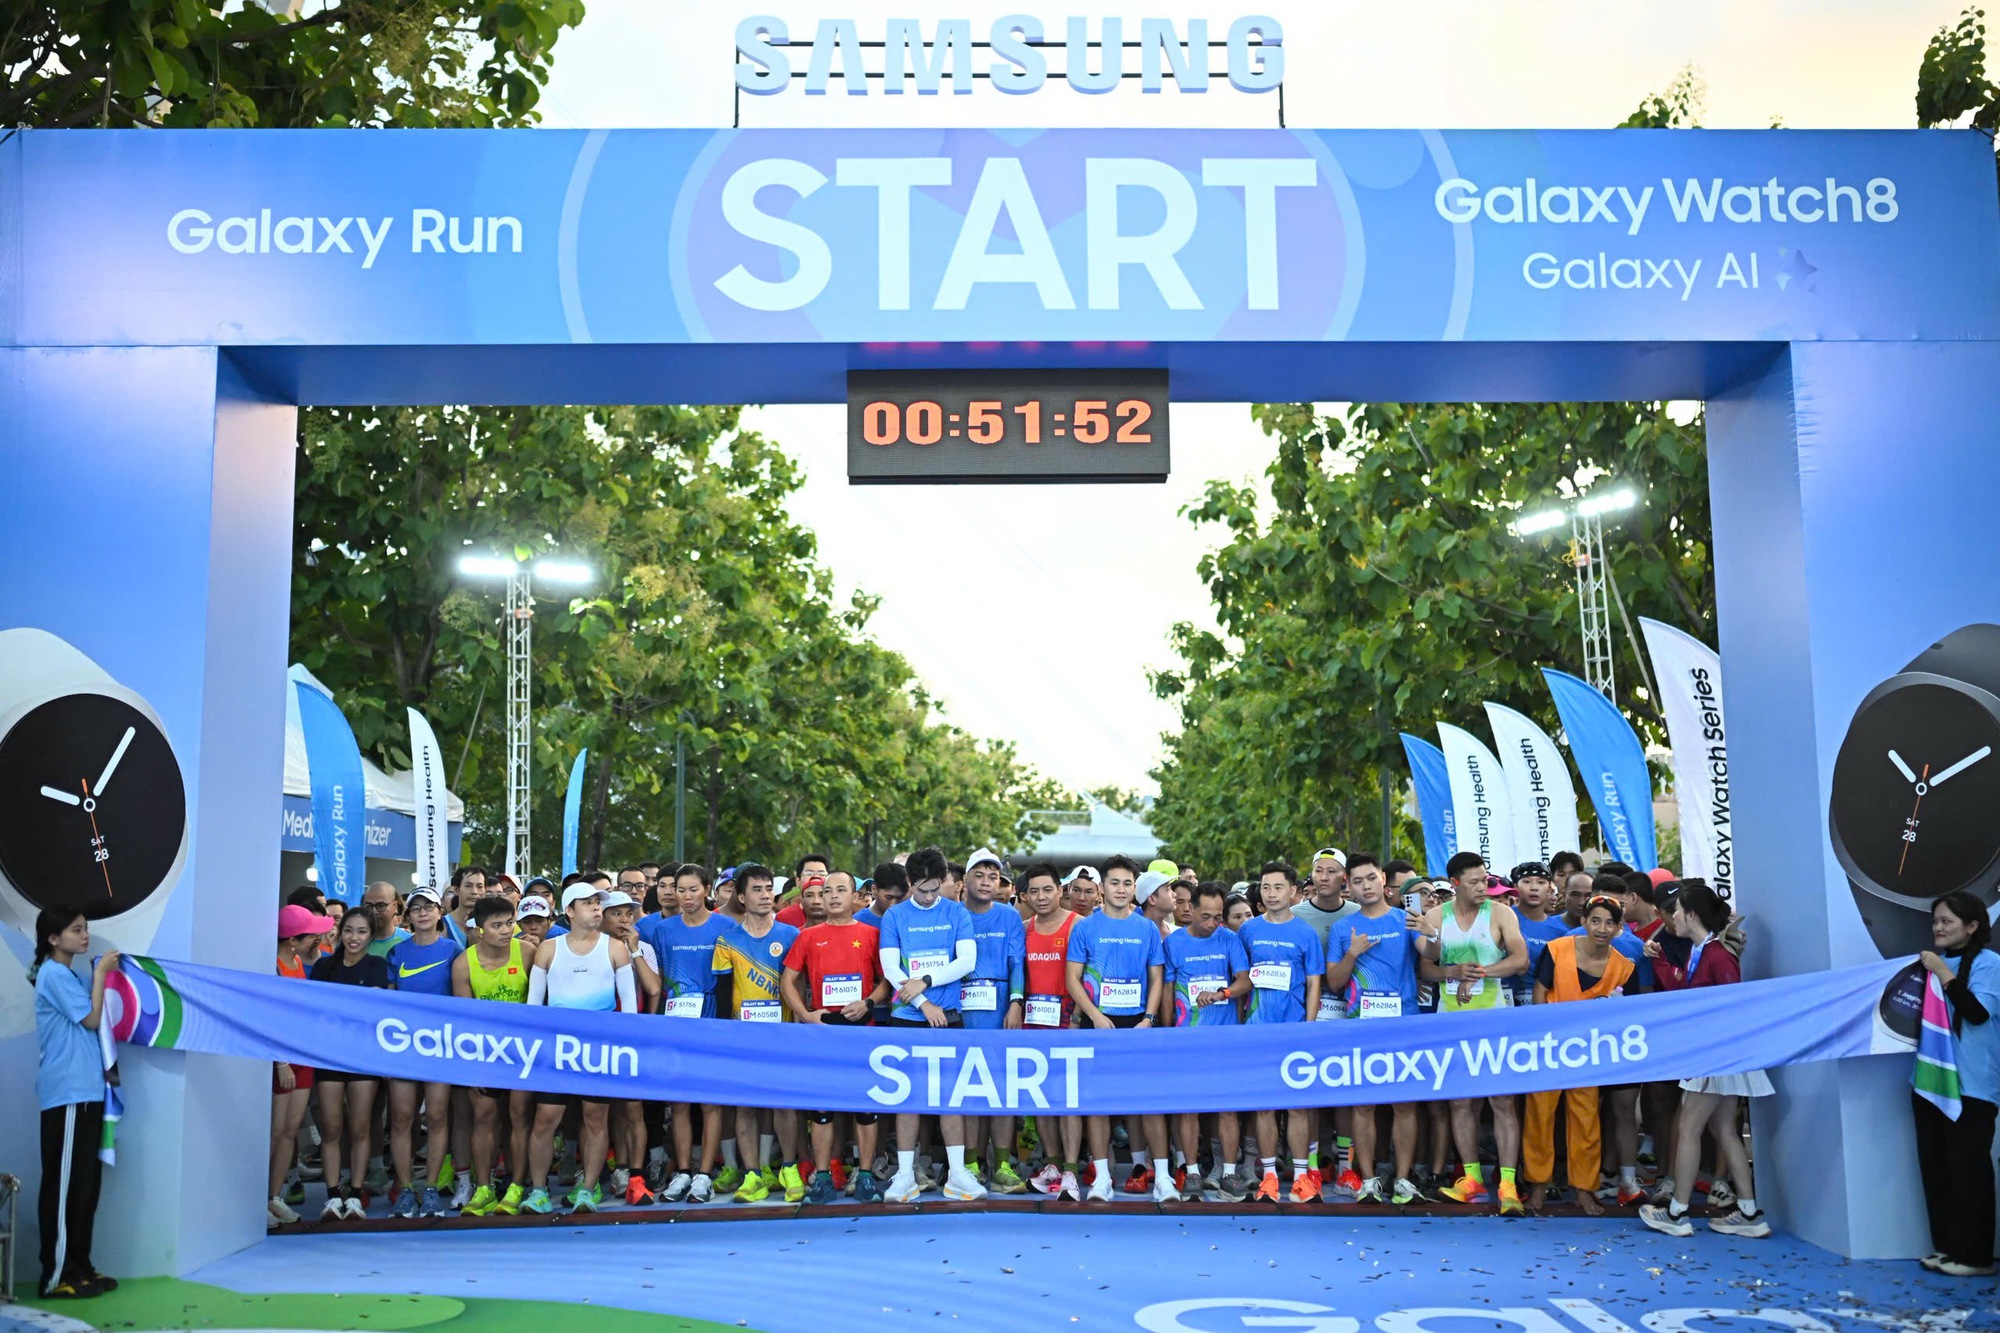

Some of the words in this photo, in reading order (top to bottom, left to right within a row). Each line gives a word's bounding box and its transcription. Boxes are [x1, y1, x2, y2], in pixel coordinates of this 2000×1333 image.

[734, 14, 1285, 96] SAMSUNG
[714, 156, 1317, 312] START
[1434, 178, 1653, 236] Galaxy
[1662, 177, 1900, 224] Watch8
[166, 208, 394, 269] Galaxy
[412, 208, 524, 254] Run
[1522, 252, 1703, 301] Galaxy
[1716, 252, 1759, 289] AI
[862, 399, 1152, 445] 00:51:52
[1691, 667, 1725, 742] Series
[423, 745, 433, 800] Health
[1467, 754, 1487, 803] Health
[1520, 737, 1545, 792] Health
[1602, 771, 1620, 807] Run
[1707, 745, 1731, 827] Watch
[332, 784, 344, 821] Run
[1905, 817, 1920, 828] SAT
[90, 835, 105, 847] SAT
[93, 848, 110, 863] 28
[332, 825, 349, 897] Galaxy
[426, 804, 437, 889] Samsung
[1477, 806, 1492, 874] amsung
[1610, 810, 1637, 870] alaxy
[1901, 829, 1917, 843] 28
[1714, 829, 1733, 901] alaxy
[1027, 952, 1061, 962] UDAQUA
[1185, 955, 1210, 963] Samsung
[1253, 940, 1278, 948] Samsung
[376, 1017, 543, 1080] Galaxy
[555, 1034, 639, 1077] Run
[866, 1045, 1095, 1109] START
[1280, 1047, 1454, 1090] Galaxy
[1460, 1024, 1650, 1077] Watch8
